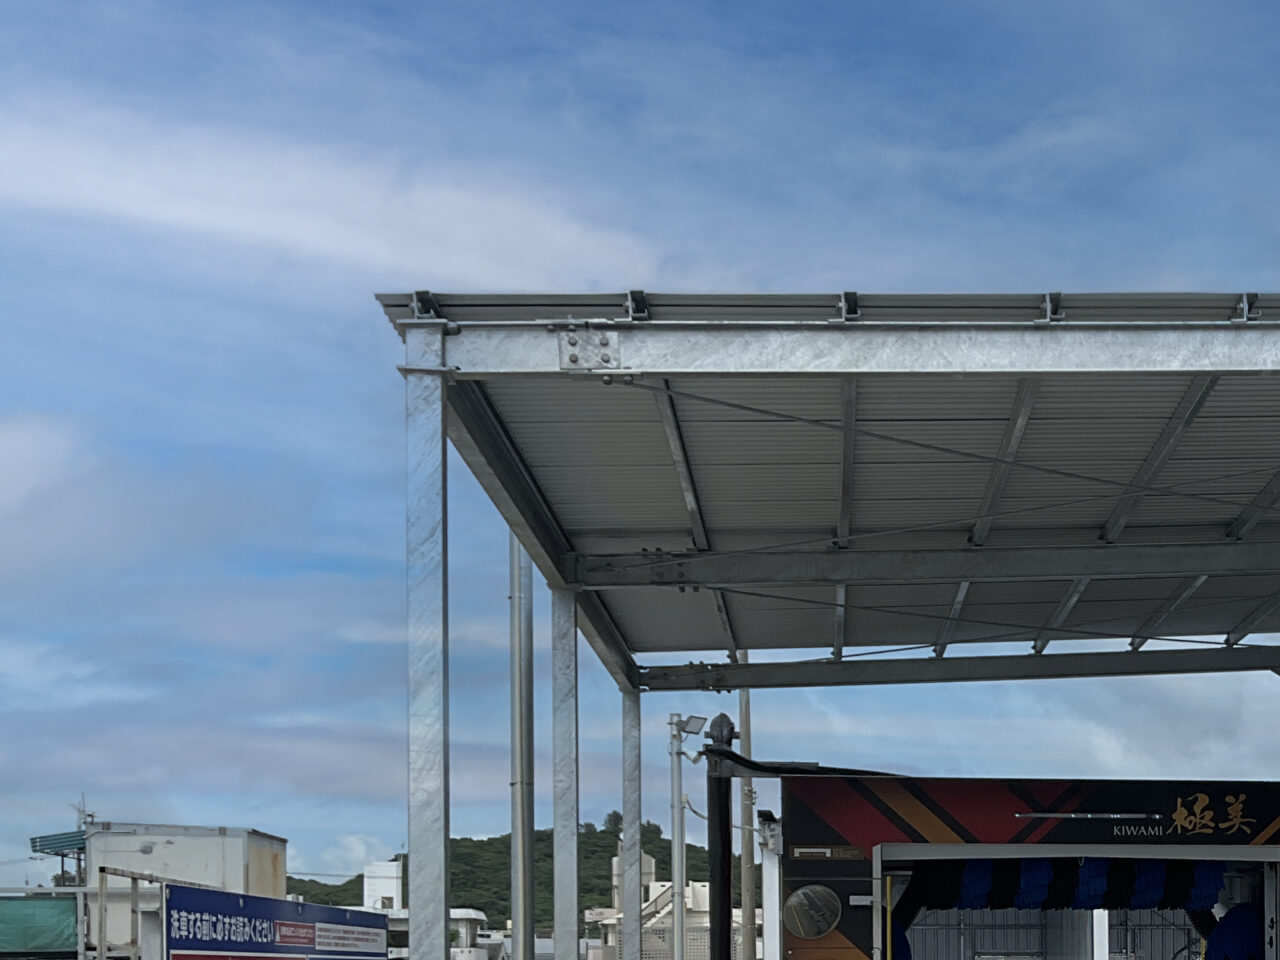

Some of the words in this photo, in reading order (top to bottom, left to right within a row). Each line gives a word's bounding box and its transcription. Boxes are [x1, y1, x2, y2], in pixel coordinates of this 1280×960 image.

[1113, 825, 1163, 836] KIWAMI
[1166, 793, 1257, 836] 極美
[171, 909, 274, 942] 洗車する前に必ずお読みください
